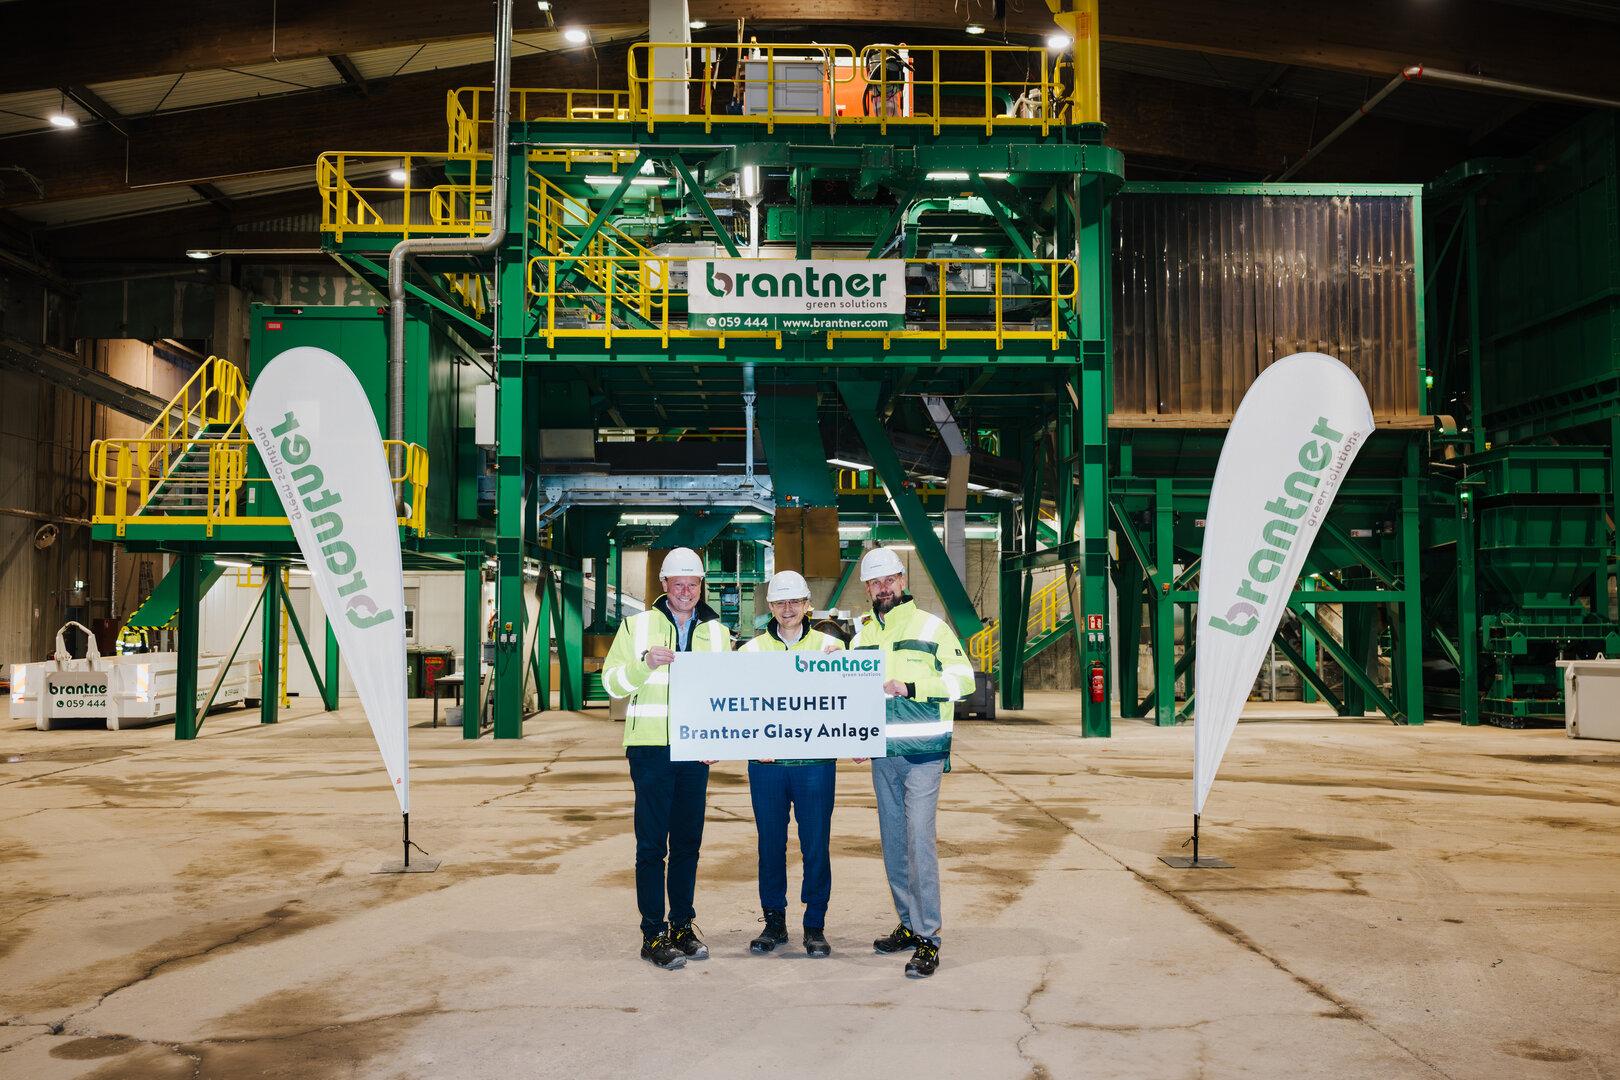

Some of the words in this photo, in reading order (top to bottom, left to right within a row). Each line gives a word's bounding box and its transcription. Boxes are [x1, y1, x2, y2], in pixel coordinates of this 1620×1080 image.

[706, 261, 887, 298] brantner
[805, 301, 836, 311] green
[839, 299, 888, 309] solutions
[718, 316, 741, 328] 059
[743, 316, 769, 328] 444
[782, 317, 888, 328] www.brantner.com
[1307, 491, 1330, 527] green
[1326, 429, 1361, 488] solutions
[1208, 415, 1345, 637] brantner
[795, 654, 881, 673] brantner
[48, 682, 108, 695] brantne
[66, 699, 85, 708] 059
[86, 699, 106, 708] 444
[709, 695, 848, 712] WELTNEUHEIT
[679, 725, 760, 740] Brantner
[763, 723, 813, 742] Glasy
[816, 723, 880, 741] Anlage
